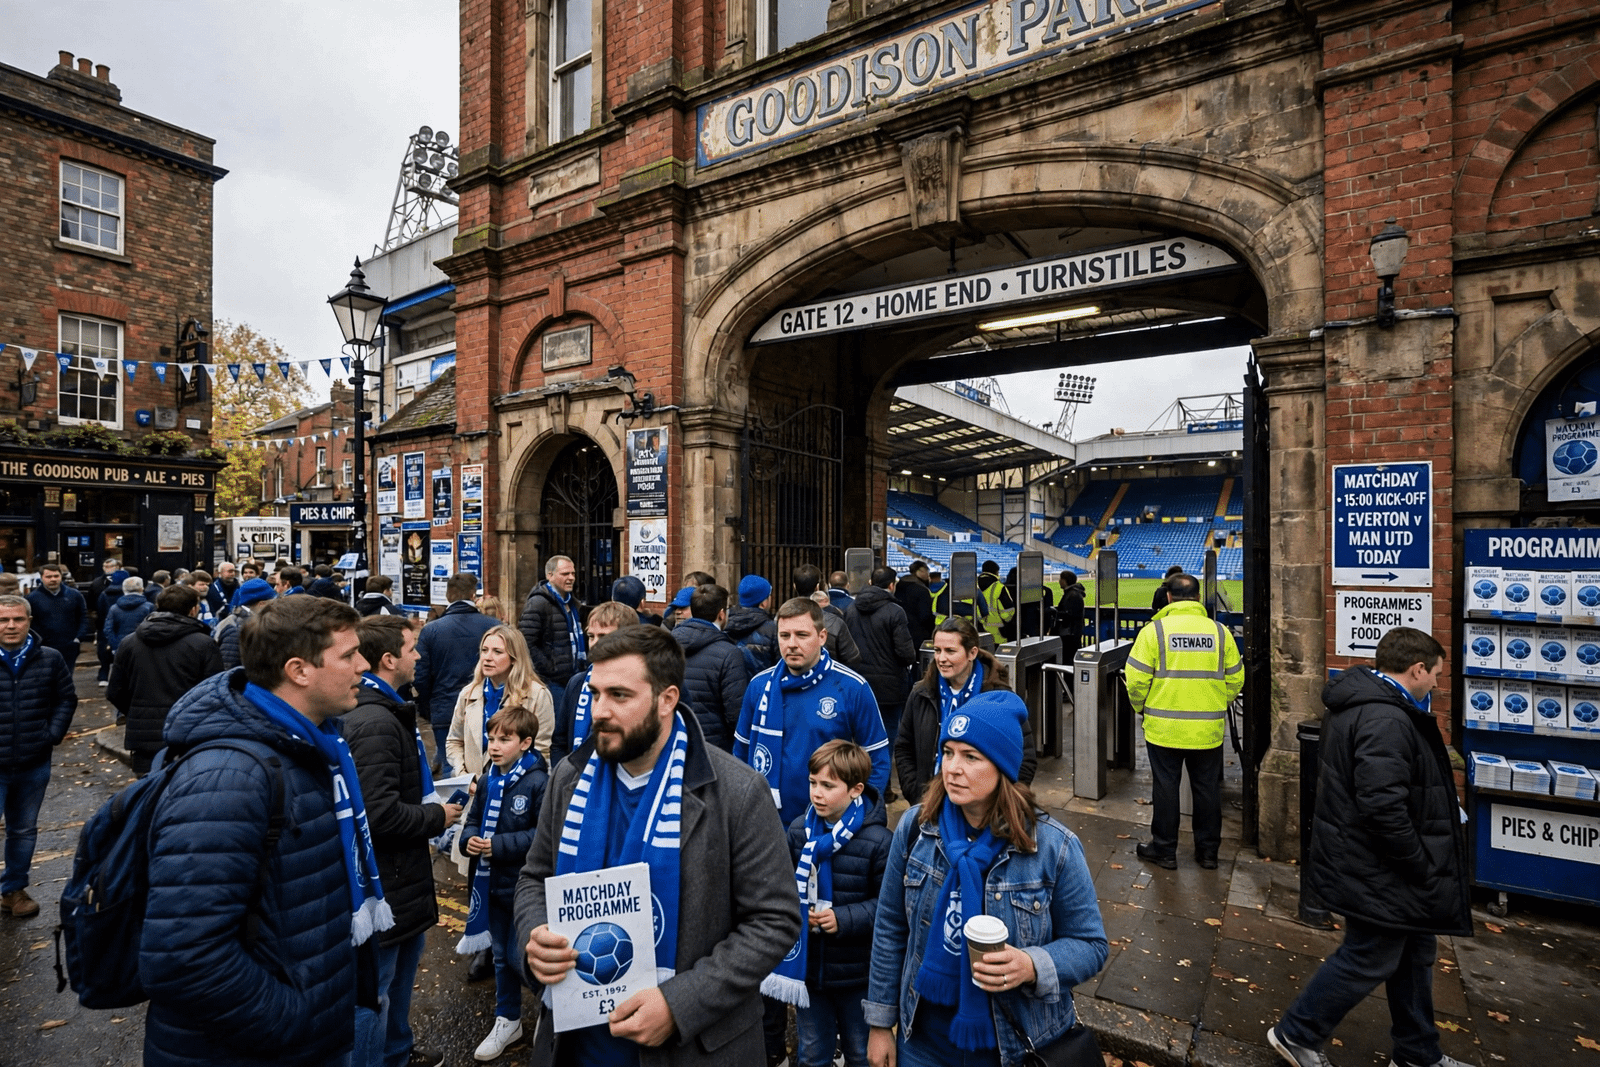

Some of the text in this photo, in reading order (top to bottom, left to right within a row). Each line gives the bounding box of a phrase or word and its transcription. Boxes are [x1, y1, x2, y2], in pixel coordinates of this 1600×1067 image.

[726, 0, 1167, 147] GOODISON PA
[780, 242, 1187, 334] GATE 12 HOME END TURNSTILES
[1, 461, 205, 486] THE GOODISON PUB ALE PIES
[1344, 471, 1419, 489] MATCHDAY
[1344, 492, 1427, 507] 15:00 KICK-OFF
[300, 507, 320, 520] PIES
[321, 507, 329, 520] &
[1347, 511, 1422, 527] EVERTON v
[1348, 531, 1413, 546] MAN UTD
[1356, 549, 1402, 565] TODAY
[1344, 596, 1422, 611] PROGRAMMES
[1362, 612, 1402, 626] MERCH
[1351, 627, 1381, 640] FOOD
[1171, 637, 1213, 649] STEWARD
[1502, 816, 1600, 848] PIES & CHIP
[563, 880, 632, 905] MATCHDAY
[559, 896, 641, 922] PROGRAMME
[582, 989, 602, 999] EST.
[599, 998, 615, 1015] £3
